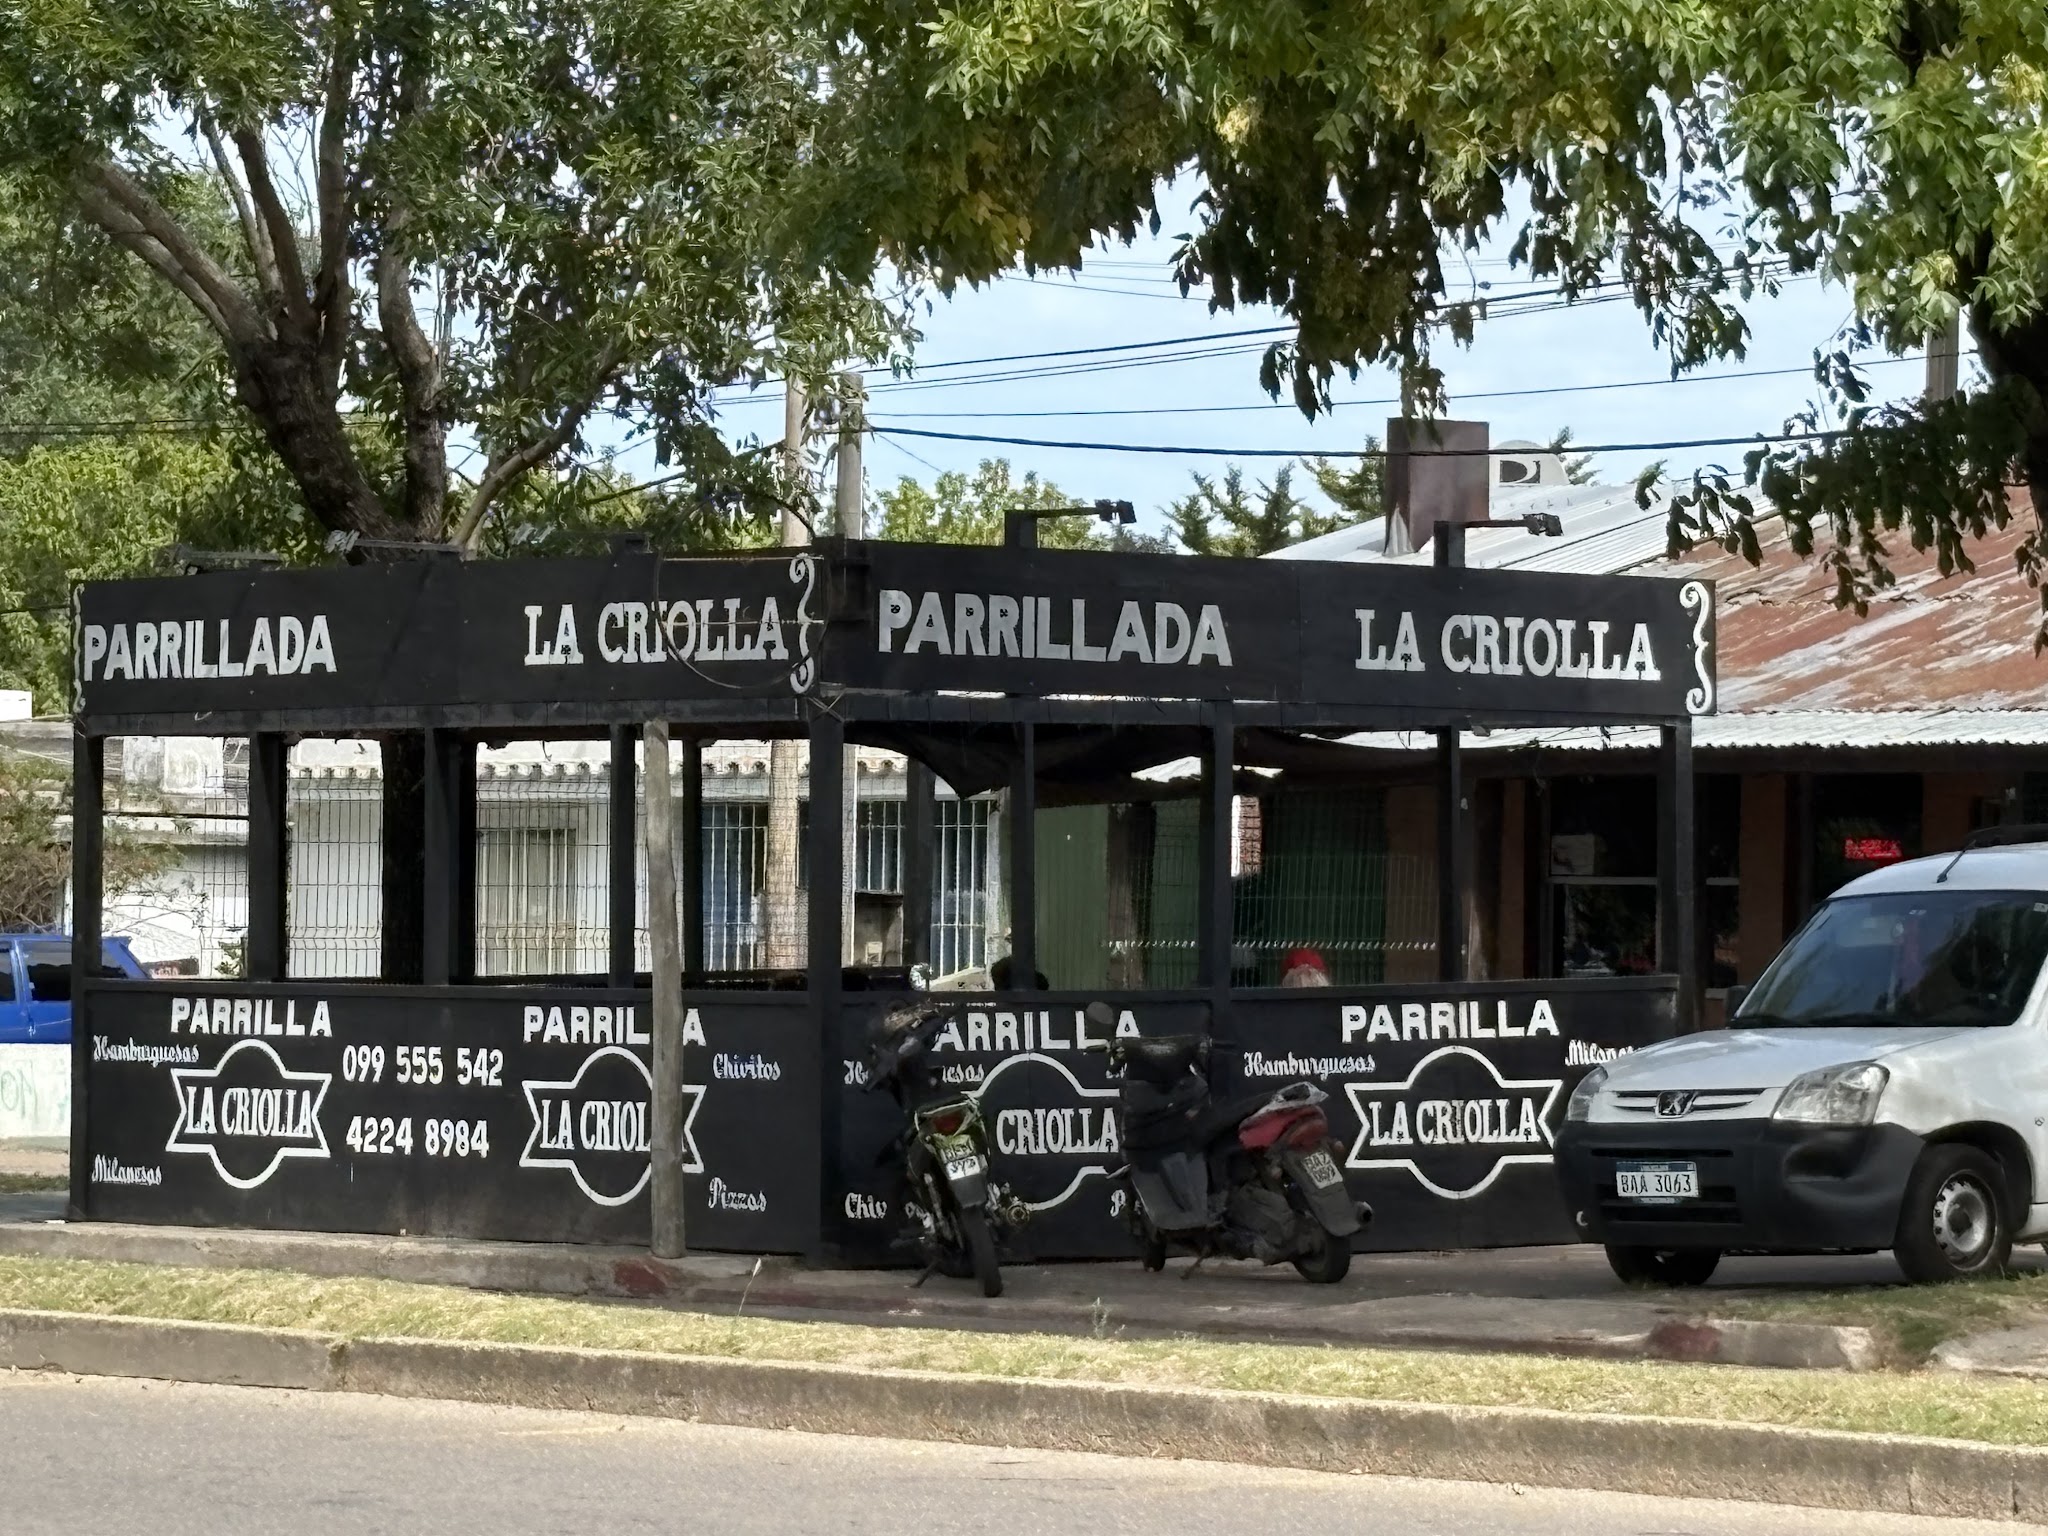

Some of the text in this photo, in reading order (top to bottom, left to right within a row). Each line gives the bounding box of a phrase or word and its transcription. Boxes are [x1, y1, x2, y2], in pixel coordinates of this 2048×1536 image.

[83, 596, 789, 682] PARRILLADA LA CRIOLLA
[878, 589, 1662, 682] PARRILLADA LA CRIOLLA
[170, 997, 333, 1038] PARRILLA
[523, 1005, 707, 1047] PARRILA
[928, 1010, 1142, 1053] ARRILLA
[1341, 999, 1561, 1043] PARRILLA
[93, 1034, 199, 1068] Hamburguesas
[342, 1044, 504, 1087] 099 555 542
[712, 1053, 781, 1081] Chivitos
[1243, 1051, 1376, 1081] Hamburguesas
[184, 1086, 314, 1139] LA CRIOLLA
[540, 1100, 688, 1152] LA CRIOL
[996, 1107, 1119, 1155] CRIOLLA
[1368, 1098, 1540, 1146] LA CRIOLLA
[345, 1115, 490, 1159] 4224 8984
[1621, 1173, 1691, 1194] BAA 3063
[845, 1192, 887, 1219] Chiv
